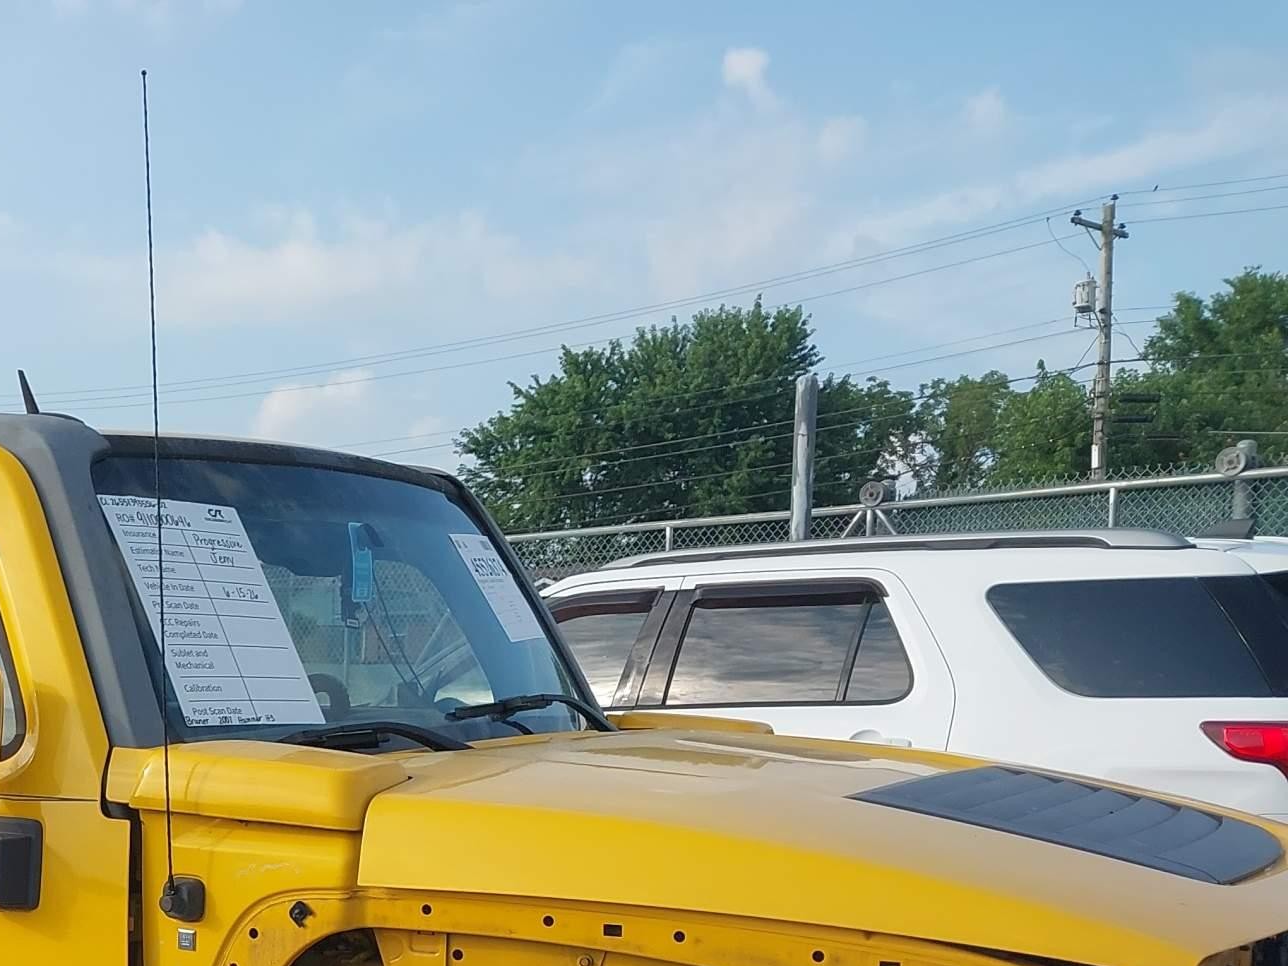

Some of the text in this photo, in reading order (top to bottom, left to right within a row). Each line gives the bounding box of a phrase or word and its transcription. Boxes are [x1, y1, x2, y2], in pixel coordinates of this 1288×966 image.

[122, 529, 157, 538] Insurance
[192, 533, 243, 551] Progressive
[137, 564, 177, 575] Tech Nme
[179, 583, 195, 593] Date
[165, 600, 183, 610] Scan
[183, 602, 200, 611] Date
[175, 619, 201, 629] Repairs
[164, 630, 219, 641] Completed Date
[175, 661, 216, 670] Mechanical
[184, 683, 223, 693] Calibration
[192, 706, 243, 716] Post Scan Date
